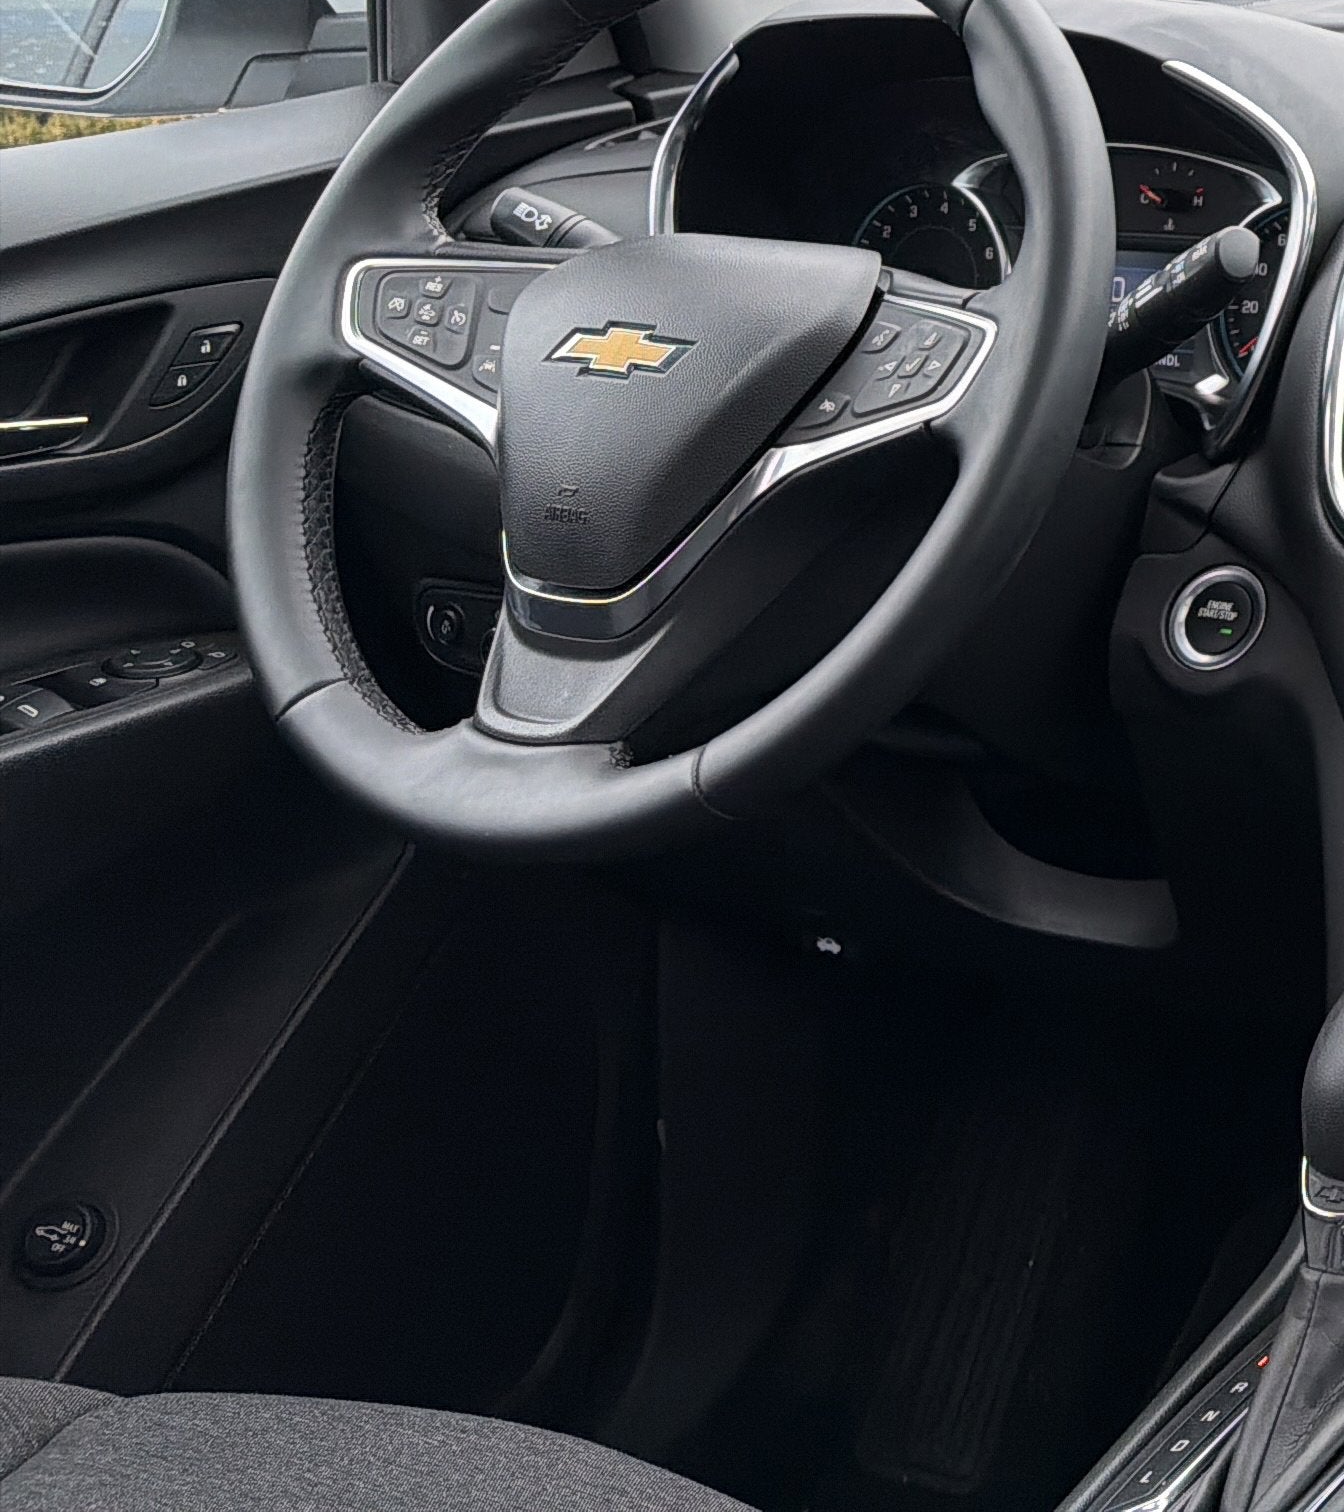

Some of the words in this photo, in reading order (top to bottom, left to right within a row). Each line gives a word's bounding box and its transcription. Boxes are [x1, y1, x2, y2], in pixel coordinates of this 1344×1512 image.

[1193, 196, 1204, 207] H
[910, 205, 918, 218] 3
[941, 202, 949, 214] 4
[968, 219, 977, 231] 5
[882, 225, 891, 238] 2
[985, 247, 994, 259] 6
[425, 282, 443, 292] RES
[1241, 300, 1259, 314] 20
[412, 335, 430, 345] SET
[1207, 600, 1234, 611] ENGINE
[1198, 607, 1238, 621] START/STOP
[1229, 1382, 1249, 1393] R
[1200, 1411, 1221, 1422] N
[1170, 1440, 1190, 1452] D
[1139, 1471, 1153, 1484] L
